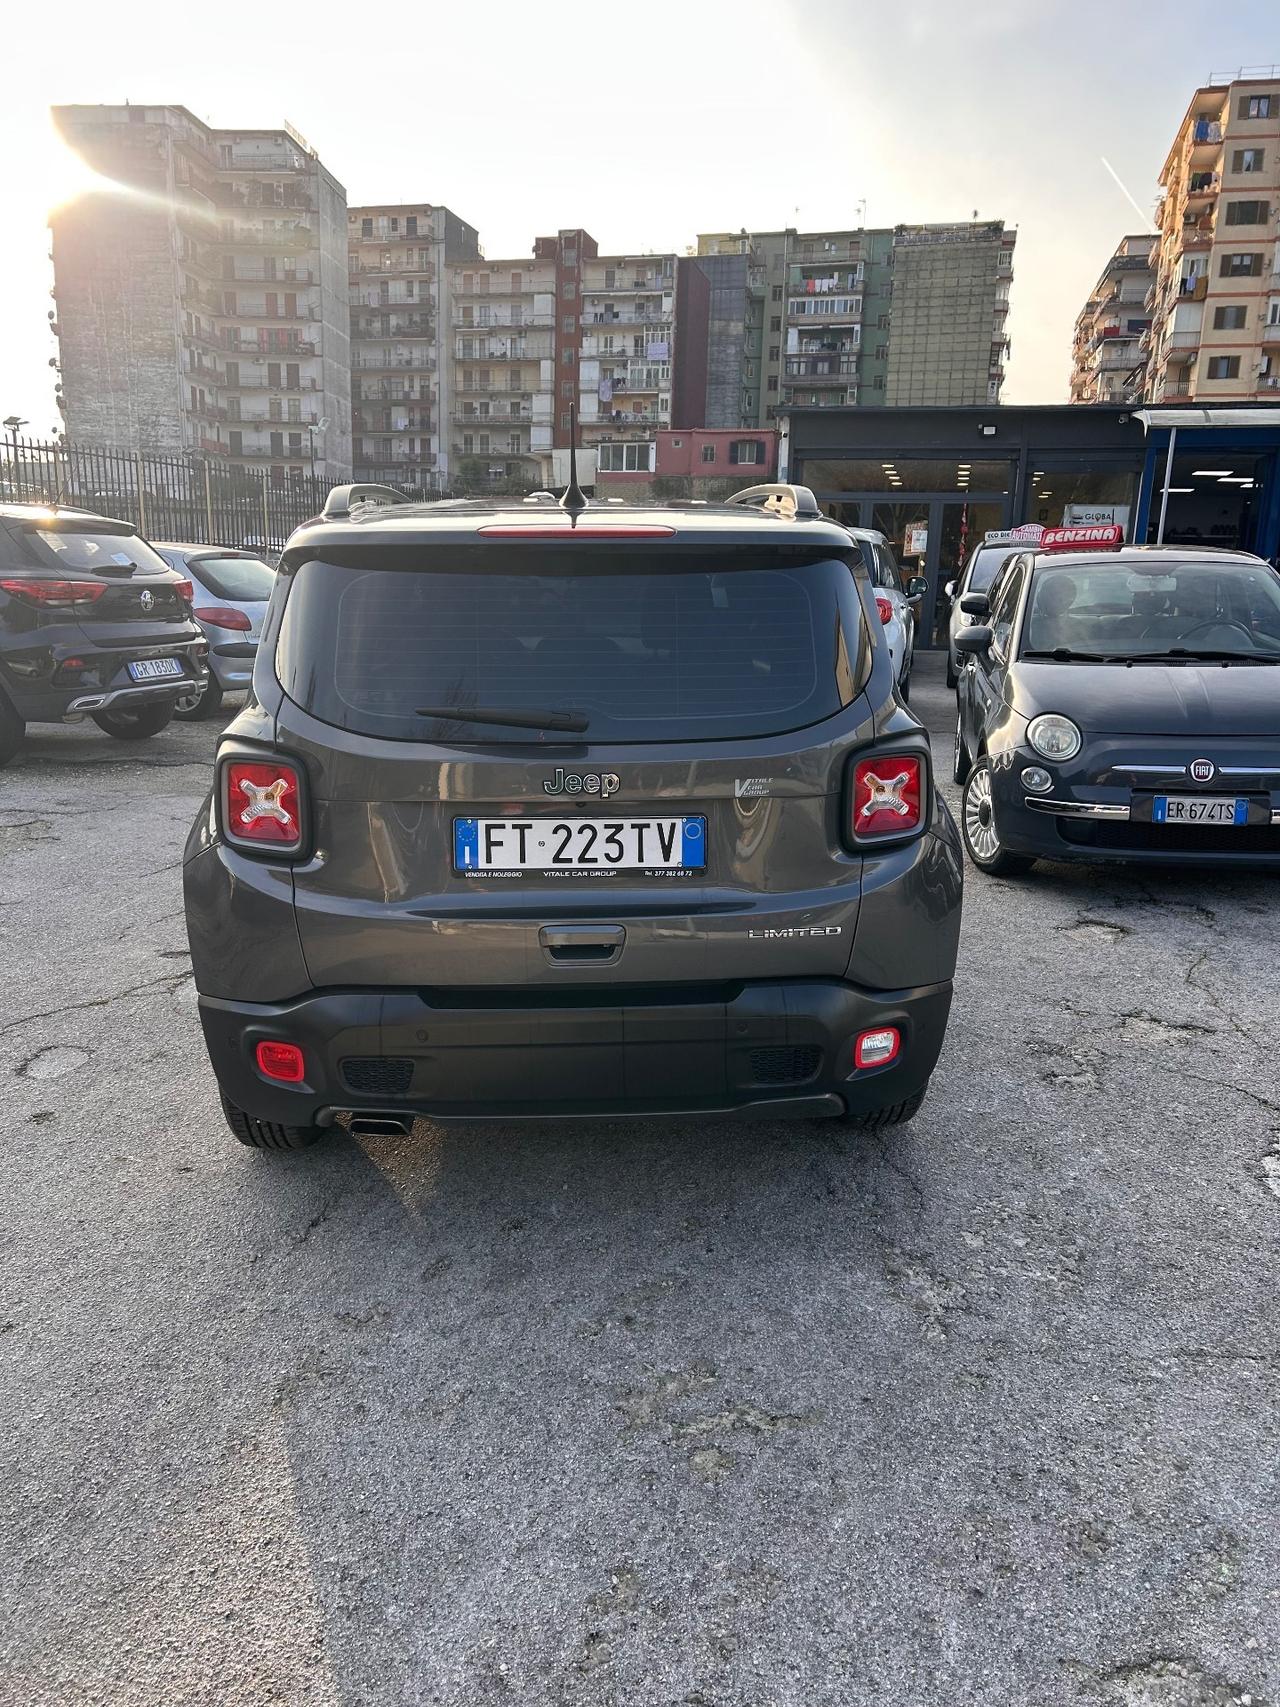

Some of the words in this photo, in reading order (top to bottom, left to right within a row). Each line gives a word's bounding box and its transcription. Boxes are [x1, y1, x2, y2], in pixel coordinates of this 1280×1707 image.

[1044, 528, 1115, 544] BENZINA
[1195, 765, 1210, 776] FIAT
[543, 768, 620, 798] Jeep
[1167, 802, 1185, 818] ER
[1189, 803, 1235, 820] 674TS
[484, 823, 533, 864] FT
[551, 822, 677, 864] 223TV
[748, 926, 842, 939] LIMITED
